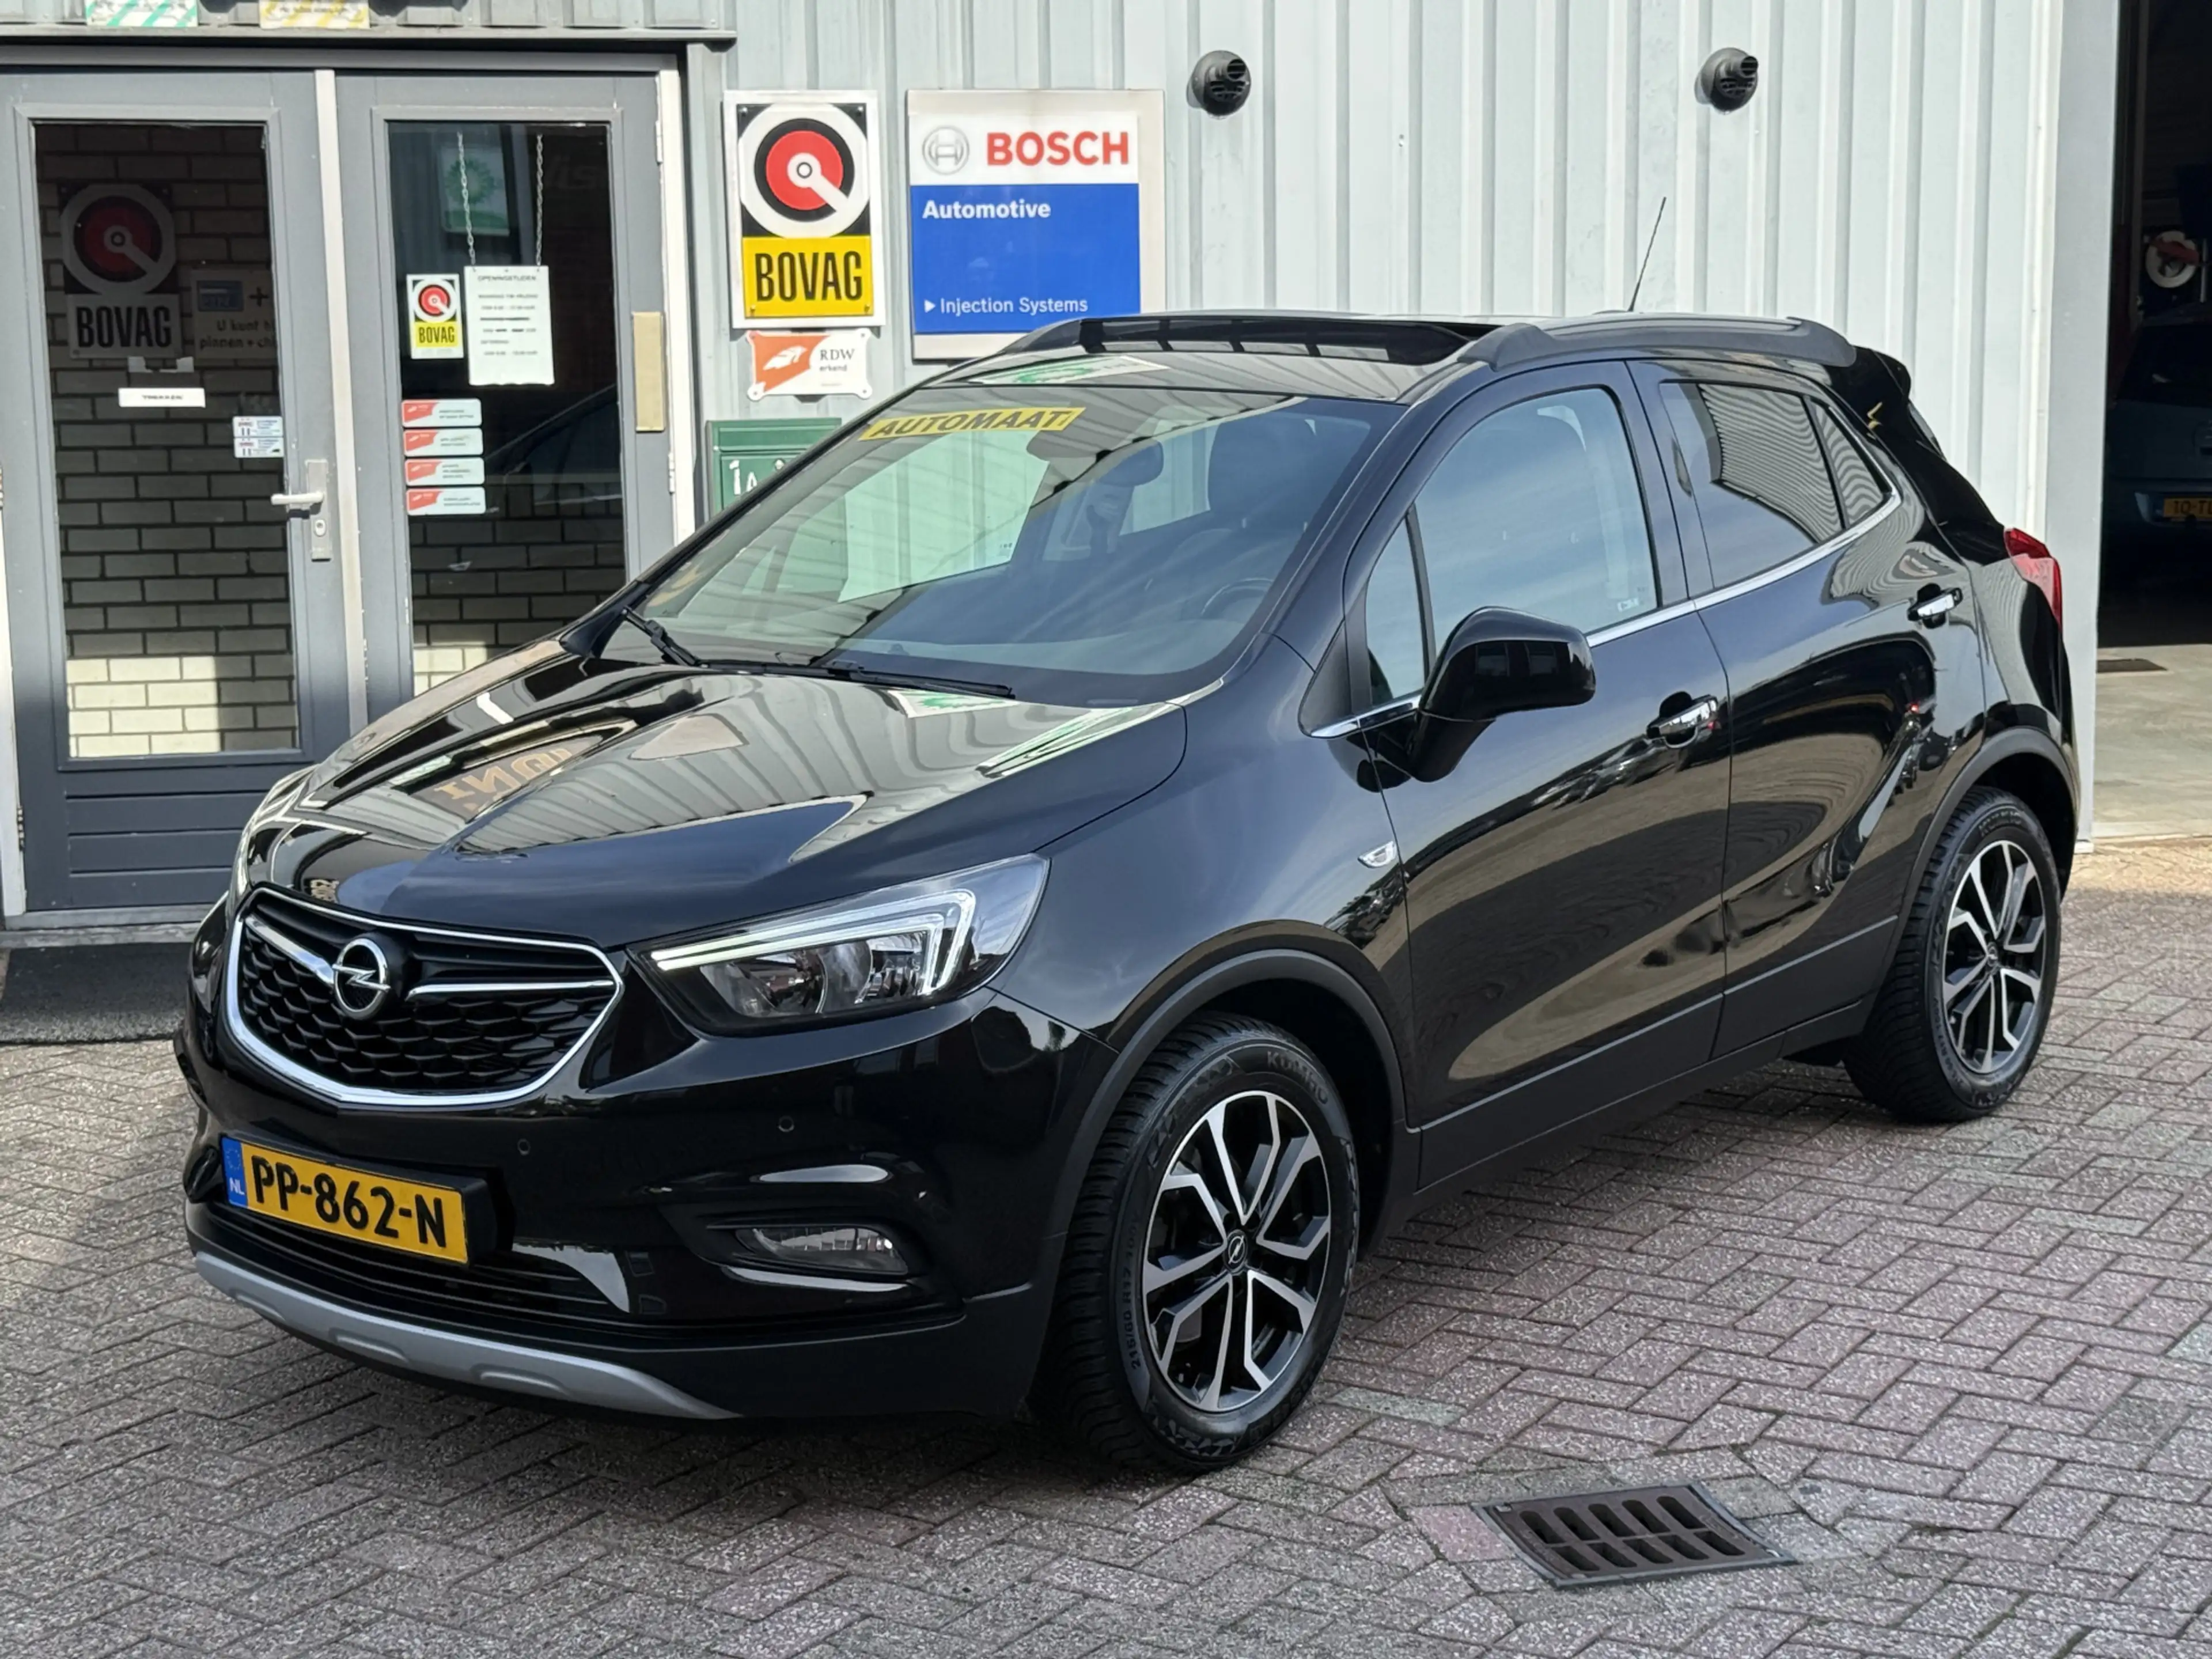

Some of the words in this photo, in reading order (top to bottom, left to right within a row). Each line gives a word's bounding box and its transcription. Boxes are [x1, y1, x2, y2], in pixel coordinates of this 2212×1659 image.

[987, 131, 1129, 166] BOSCH
[922, 198, 1051, 219] Automotive
[755, 251, 863, 302] BOVAG
[940, 297, 1014, 317] Injection
[1018, 297, 1089, 316] Systems
[76, 305, 172, 349] BOVAG
[418, 326, 455, 343] BOVAG
[820, 348, 855, 361] RDW
[229, 1177, 245, 1196] NL
[251, 1154, 447, 1248] PP-862-N
